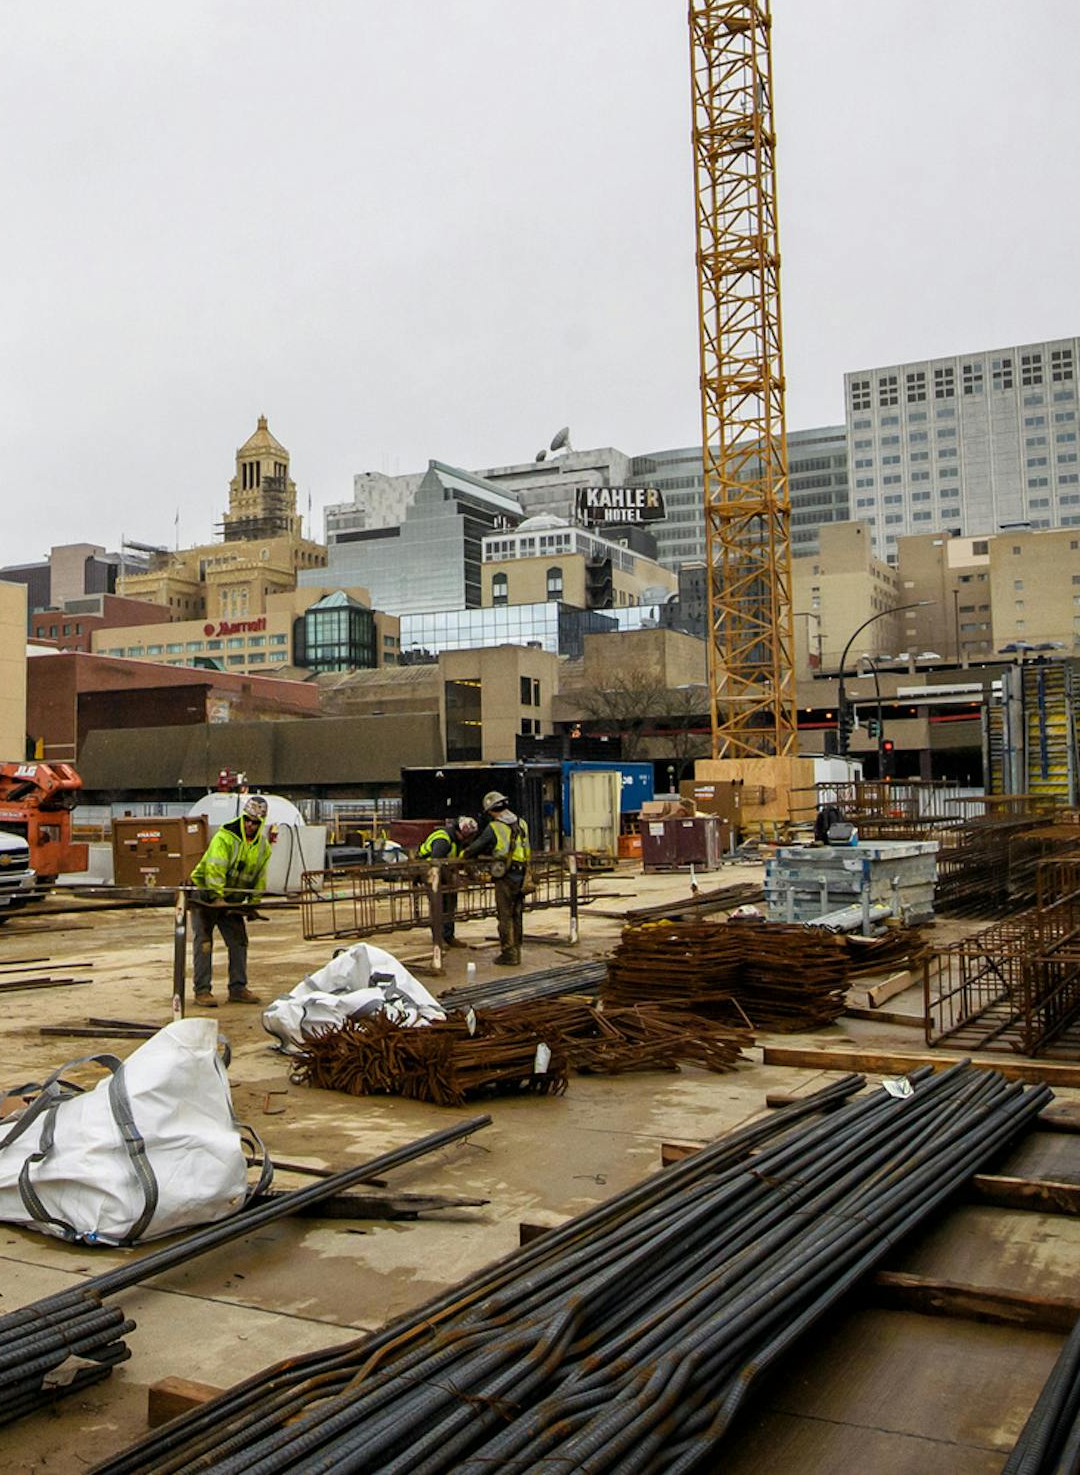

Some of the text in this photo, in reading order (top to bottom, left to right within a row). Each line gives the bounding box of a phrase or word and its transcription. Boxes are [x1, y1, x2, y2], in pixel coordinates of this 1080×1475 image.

[587, 488, 659, 507] KAHLER
[605, 509, 642, 522] HOTEL
[216, 618, 266, 637] Marriott
[14, 765, 37, 776] JLG
